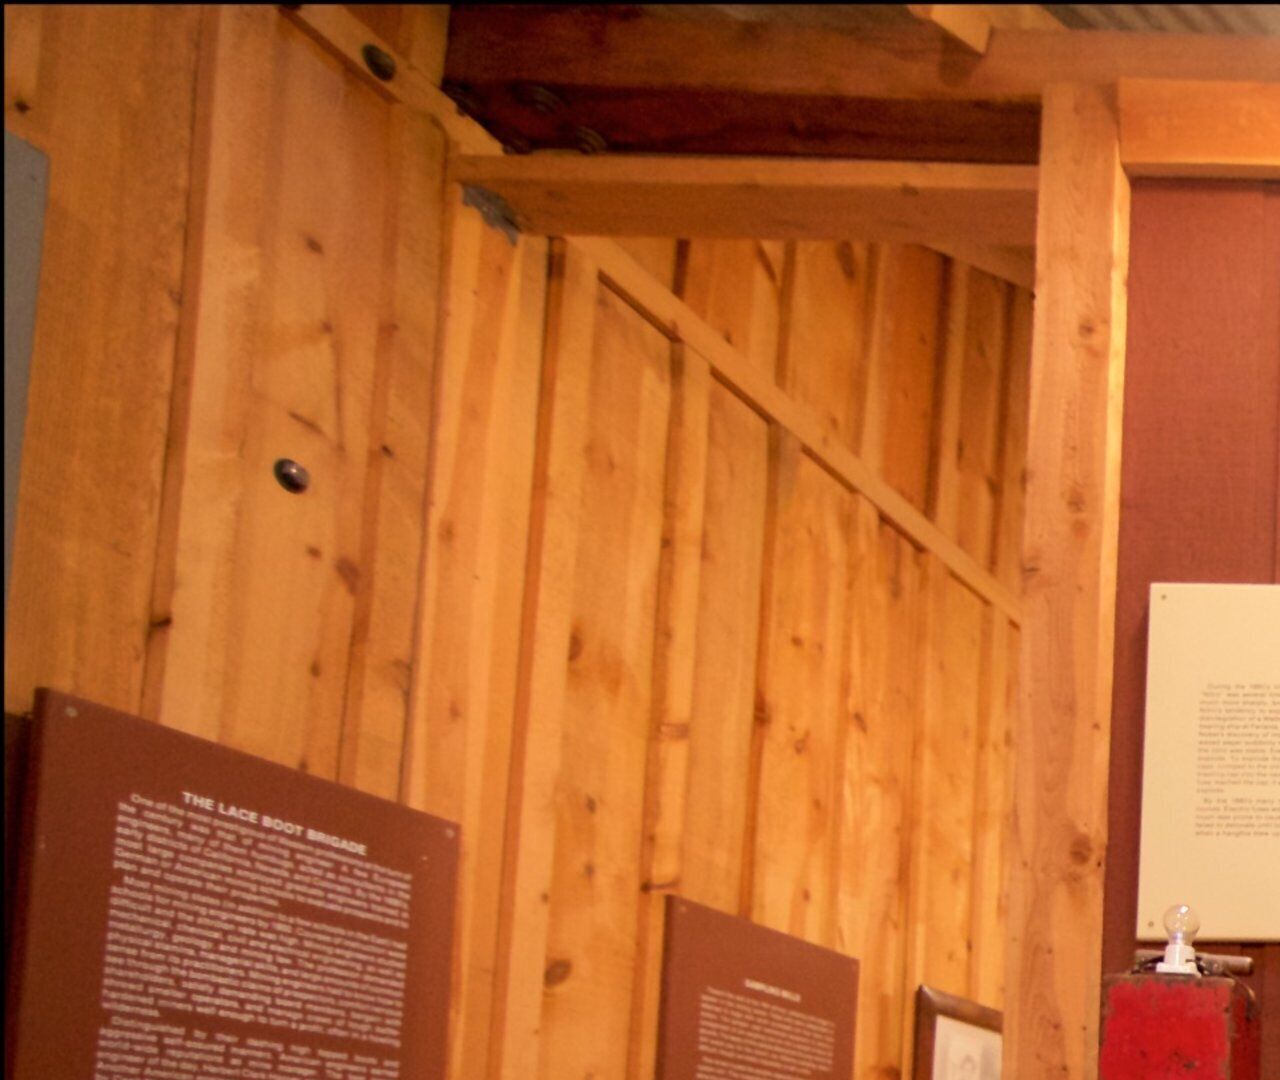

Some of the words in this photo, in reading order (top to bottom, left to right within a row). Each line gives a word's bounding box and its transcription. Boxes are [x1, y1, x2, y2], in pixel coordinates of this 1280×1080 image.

[182, 791, 215, 811] THE
[217, 803, 259, 824] LACE
[261, 815, 304, 837] BOOT
[306, 828, 368, 856] BRIGADE
